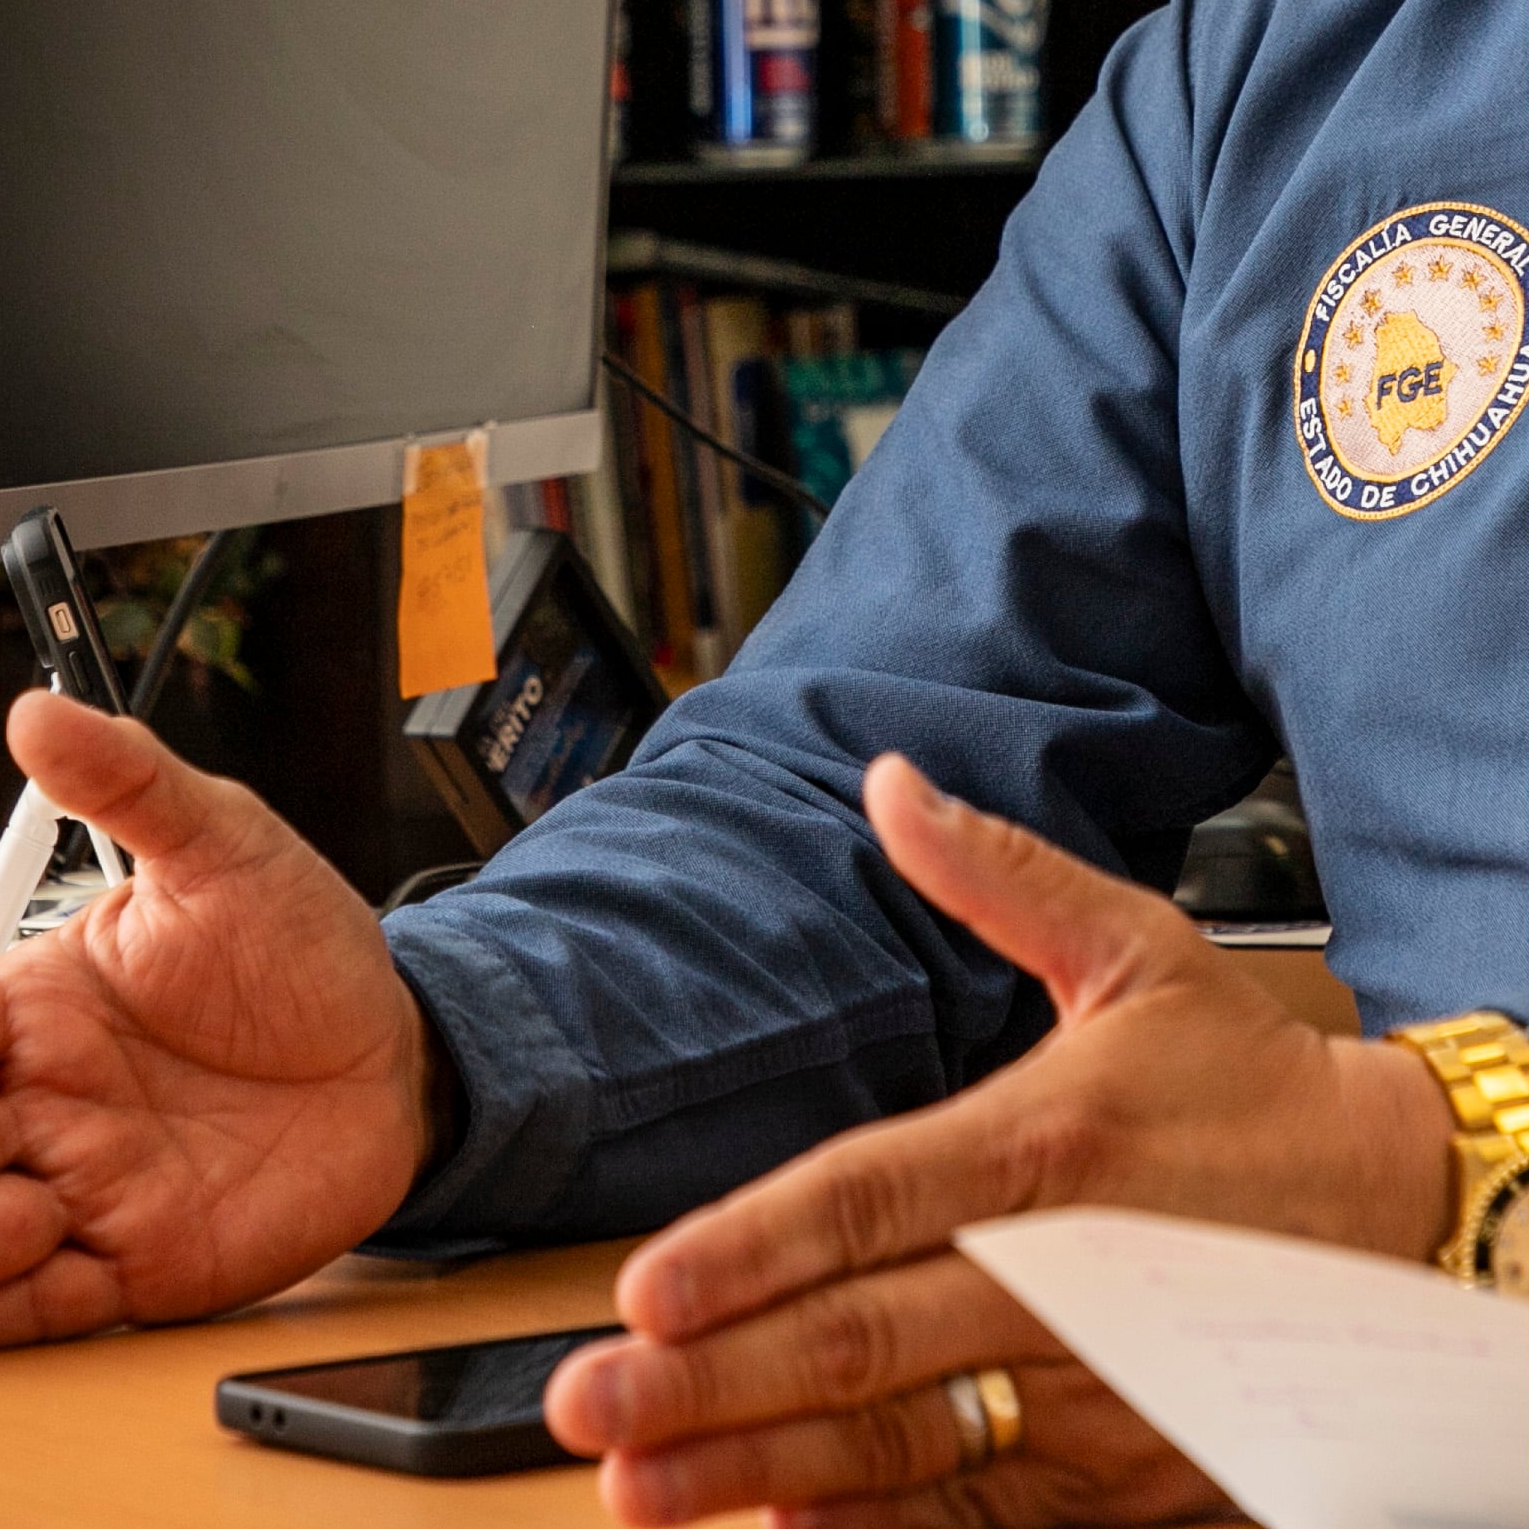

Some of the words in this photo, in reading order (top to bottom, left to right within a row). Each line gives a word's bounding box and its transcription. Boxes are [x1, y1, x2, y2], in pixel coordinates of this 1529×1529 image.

[1315, 222, 1413, 322] FISCALÍA
[1375, 361, 1444, 411] FGE
[1299, 399, 1353, 501] ESTADO
[1360, 484, 1397, 509] DE
